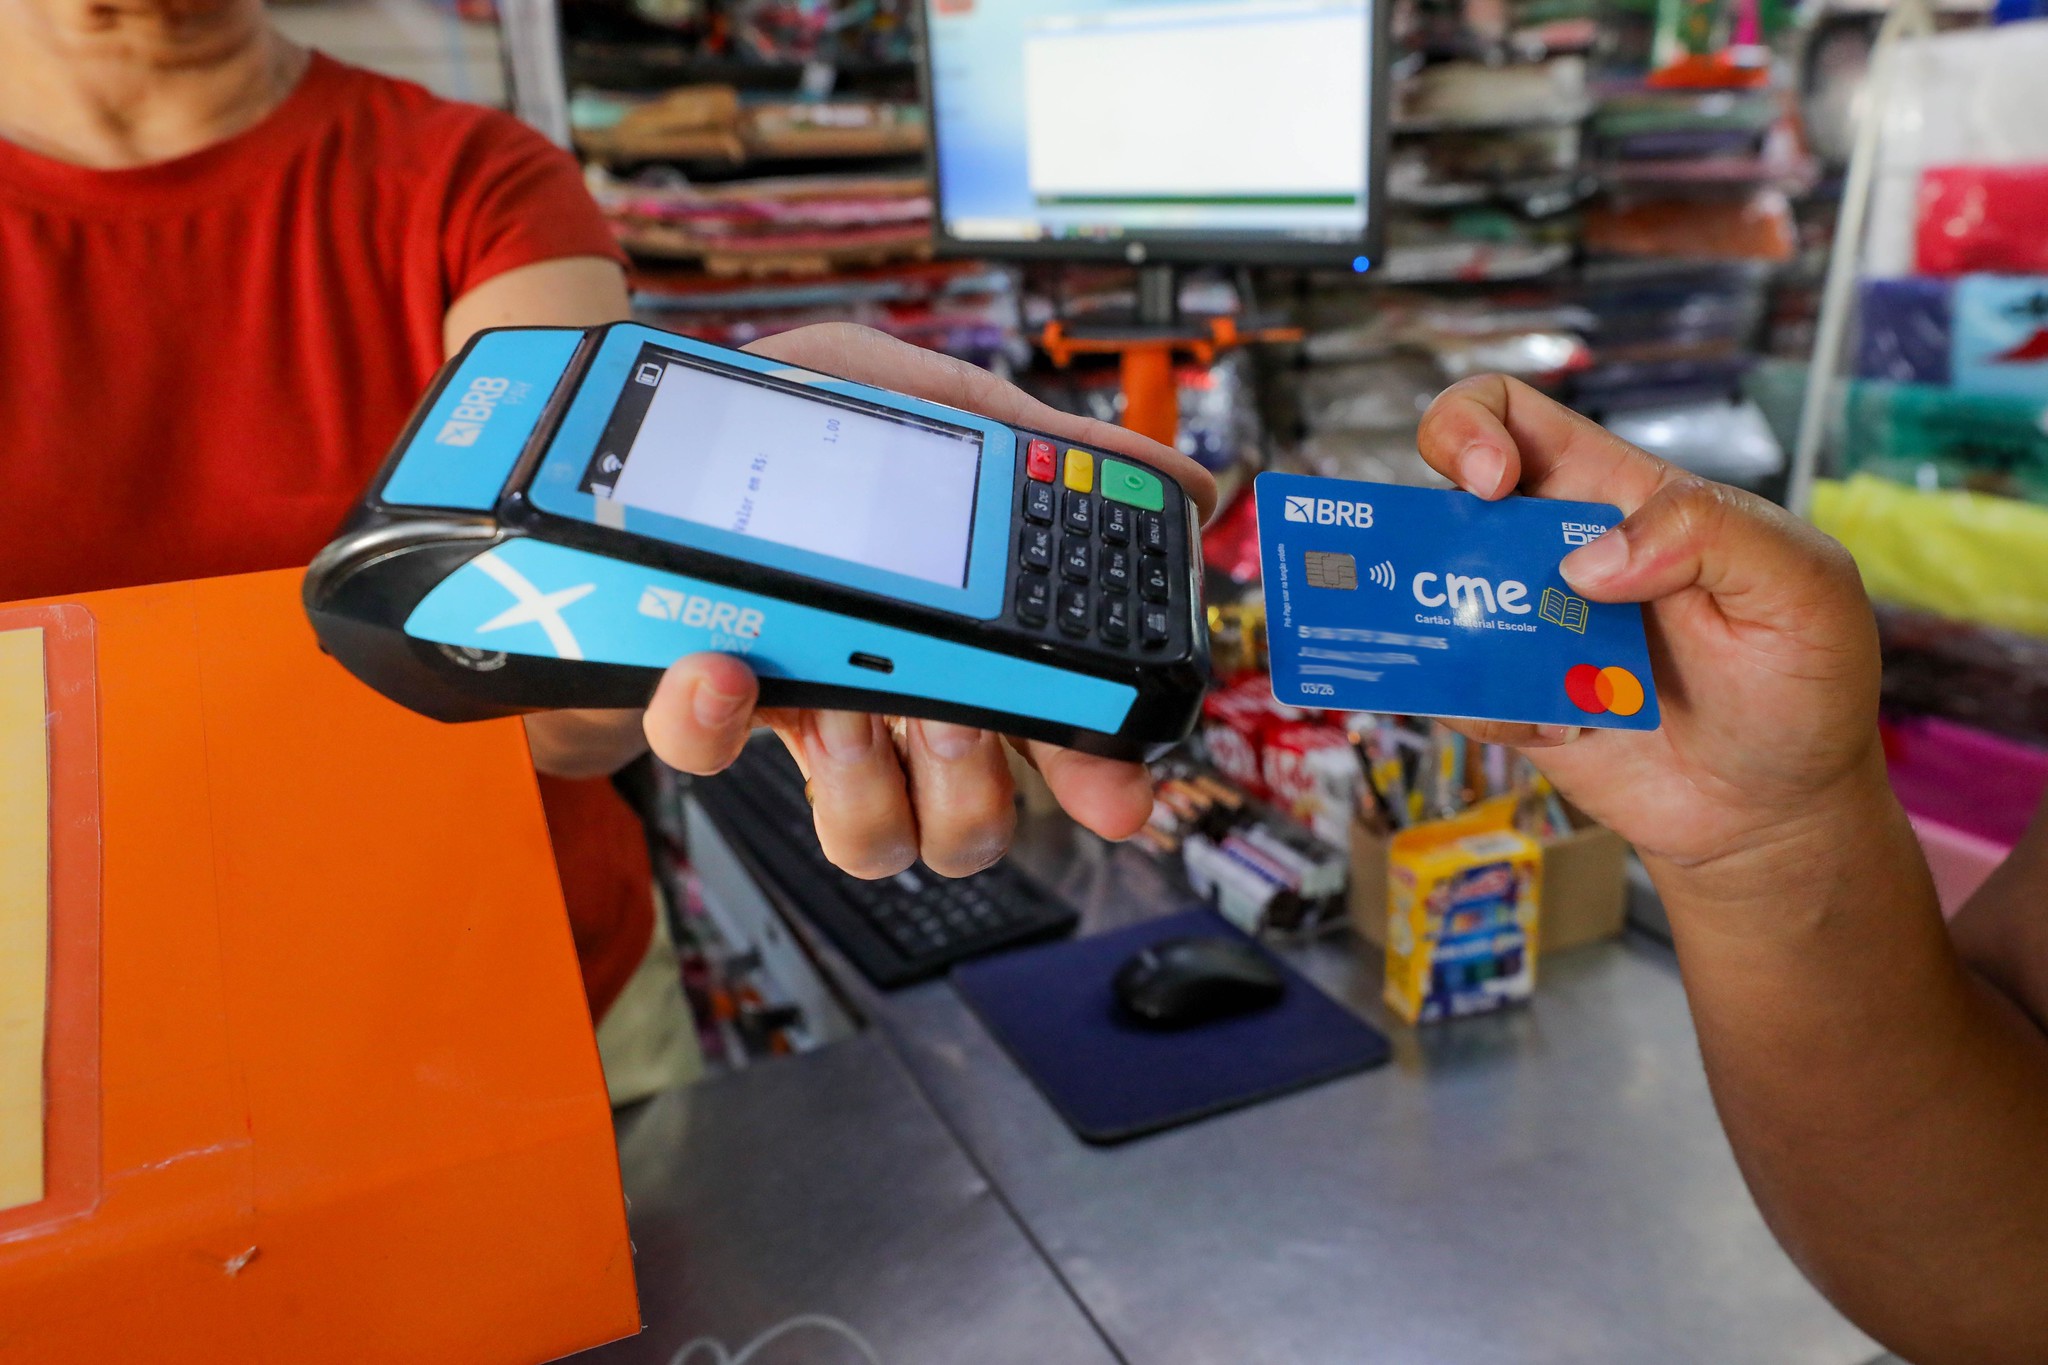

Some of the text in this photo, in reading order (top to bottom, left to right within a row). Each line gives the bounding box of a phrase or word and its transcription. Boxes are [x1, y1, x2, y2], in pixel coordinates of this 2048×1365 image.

[450, 376, 510, 422] BRB
[1033, 501, 1048, 512] 3
[1072, 511, 1088, 522] 6
[1316, 498, 1374, 529] BRB
[1109, 522, 1124, 532] 9
[1561, 521, 1608, 534] EDUCA
[1030, 545, 1047, 557] 2
[1069, 556, 1086, 568] 5
[1109, 566, 1126, 578] 8
[1412, 571, 1532, 615] cme
[1028, 596, 1043, 605] 1
[682, 595, 764, 639] BRB
[1068, 605, 1085, 617] 4
[1109, 616, 1125, 627] 7
[1415, 613, 1451, 626] Cartão
[1497, 620, 1538, 633] Escolar
